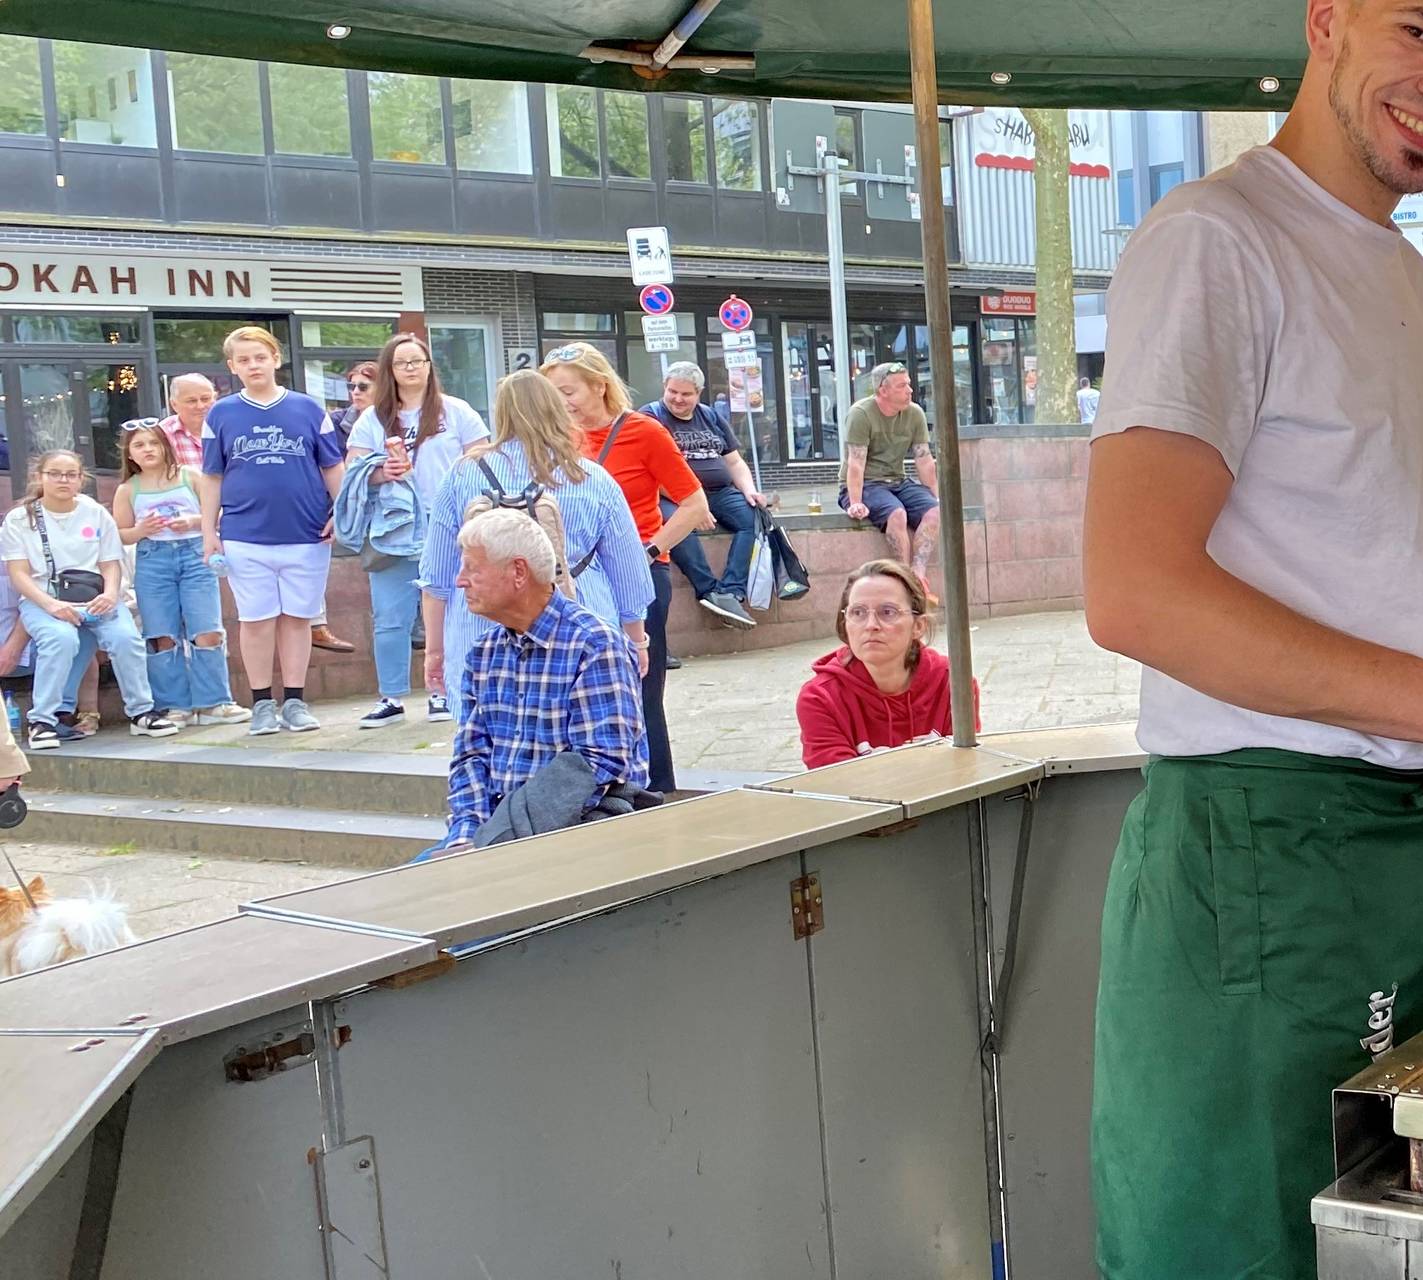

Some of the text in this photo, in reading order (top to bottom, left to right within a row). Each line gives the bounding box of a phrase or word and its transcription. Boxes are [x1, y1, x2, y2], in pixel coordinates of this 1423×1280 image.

[994, 114, 1034, 146] SHAB
[167, 268, 251, 298] INN
[516, 353, 531, 369] 2
